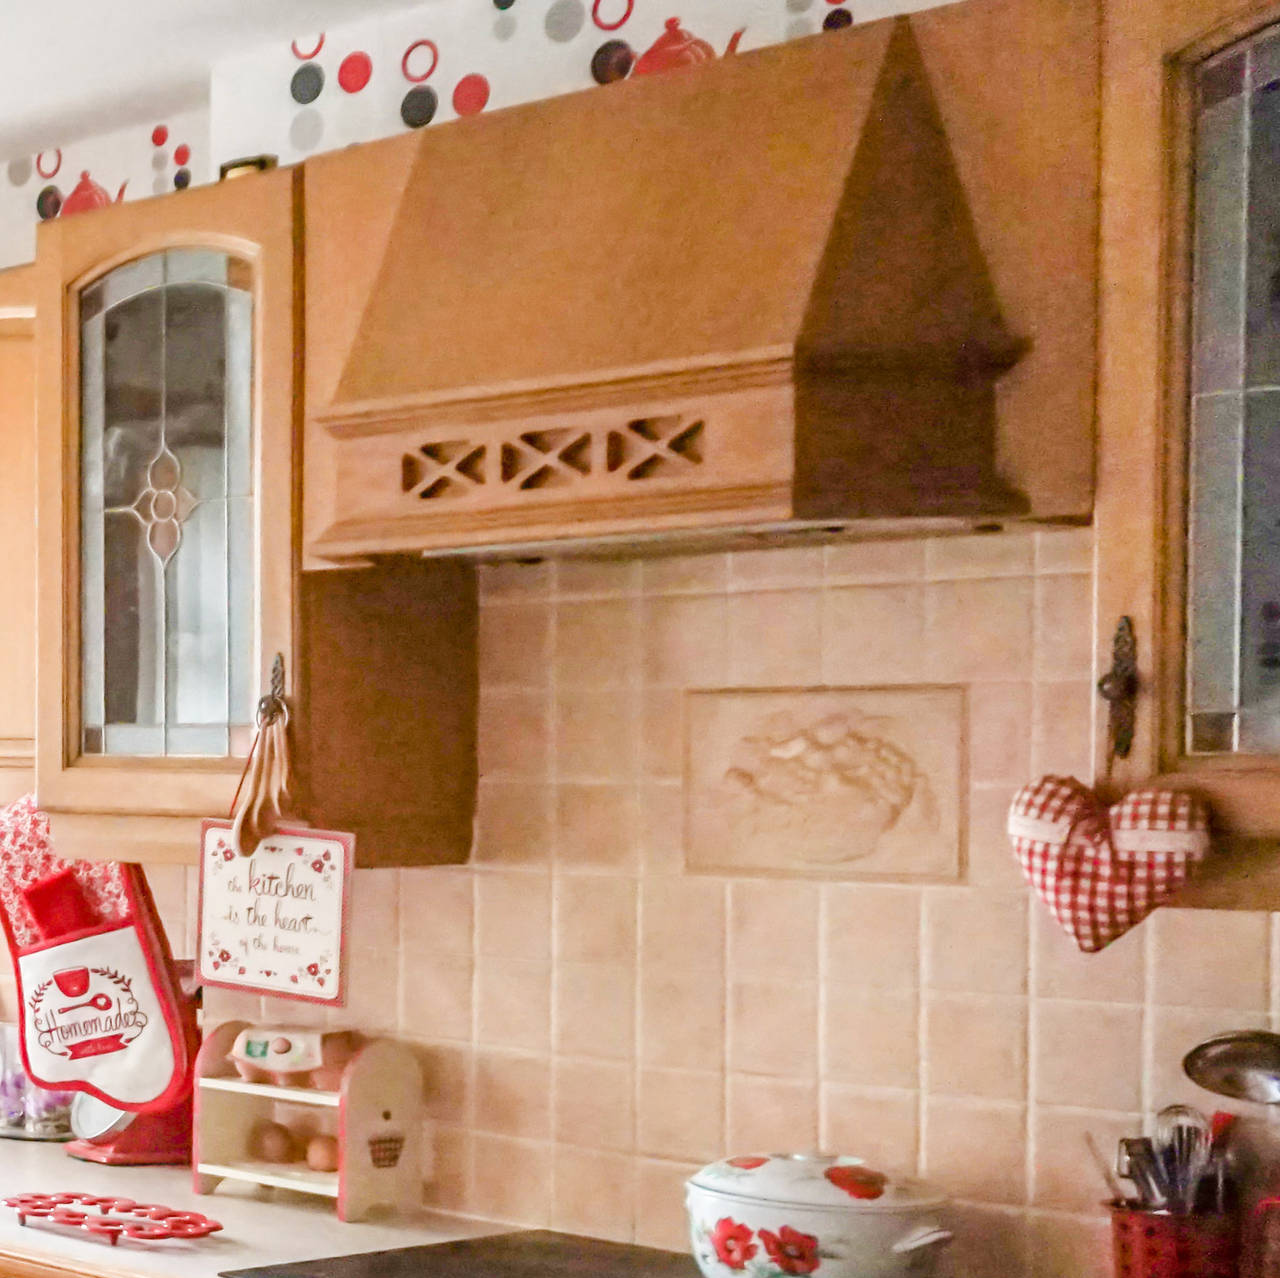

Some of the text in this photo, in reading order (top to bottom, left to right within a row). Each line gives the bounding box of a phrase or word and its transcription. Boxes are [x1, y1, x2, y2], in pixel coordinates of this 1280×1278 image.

[248, 858, 317, 901] kitchen
[246, 898, 268, 928] the
[273, 900, 314, 933] heart
[40, 996, 140, 1044] Homemade
